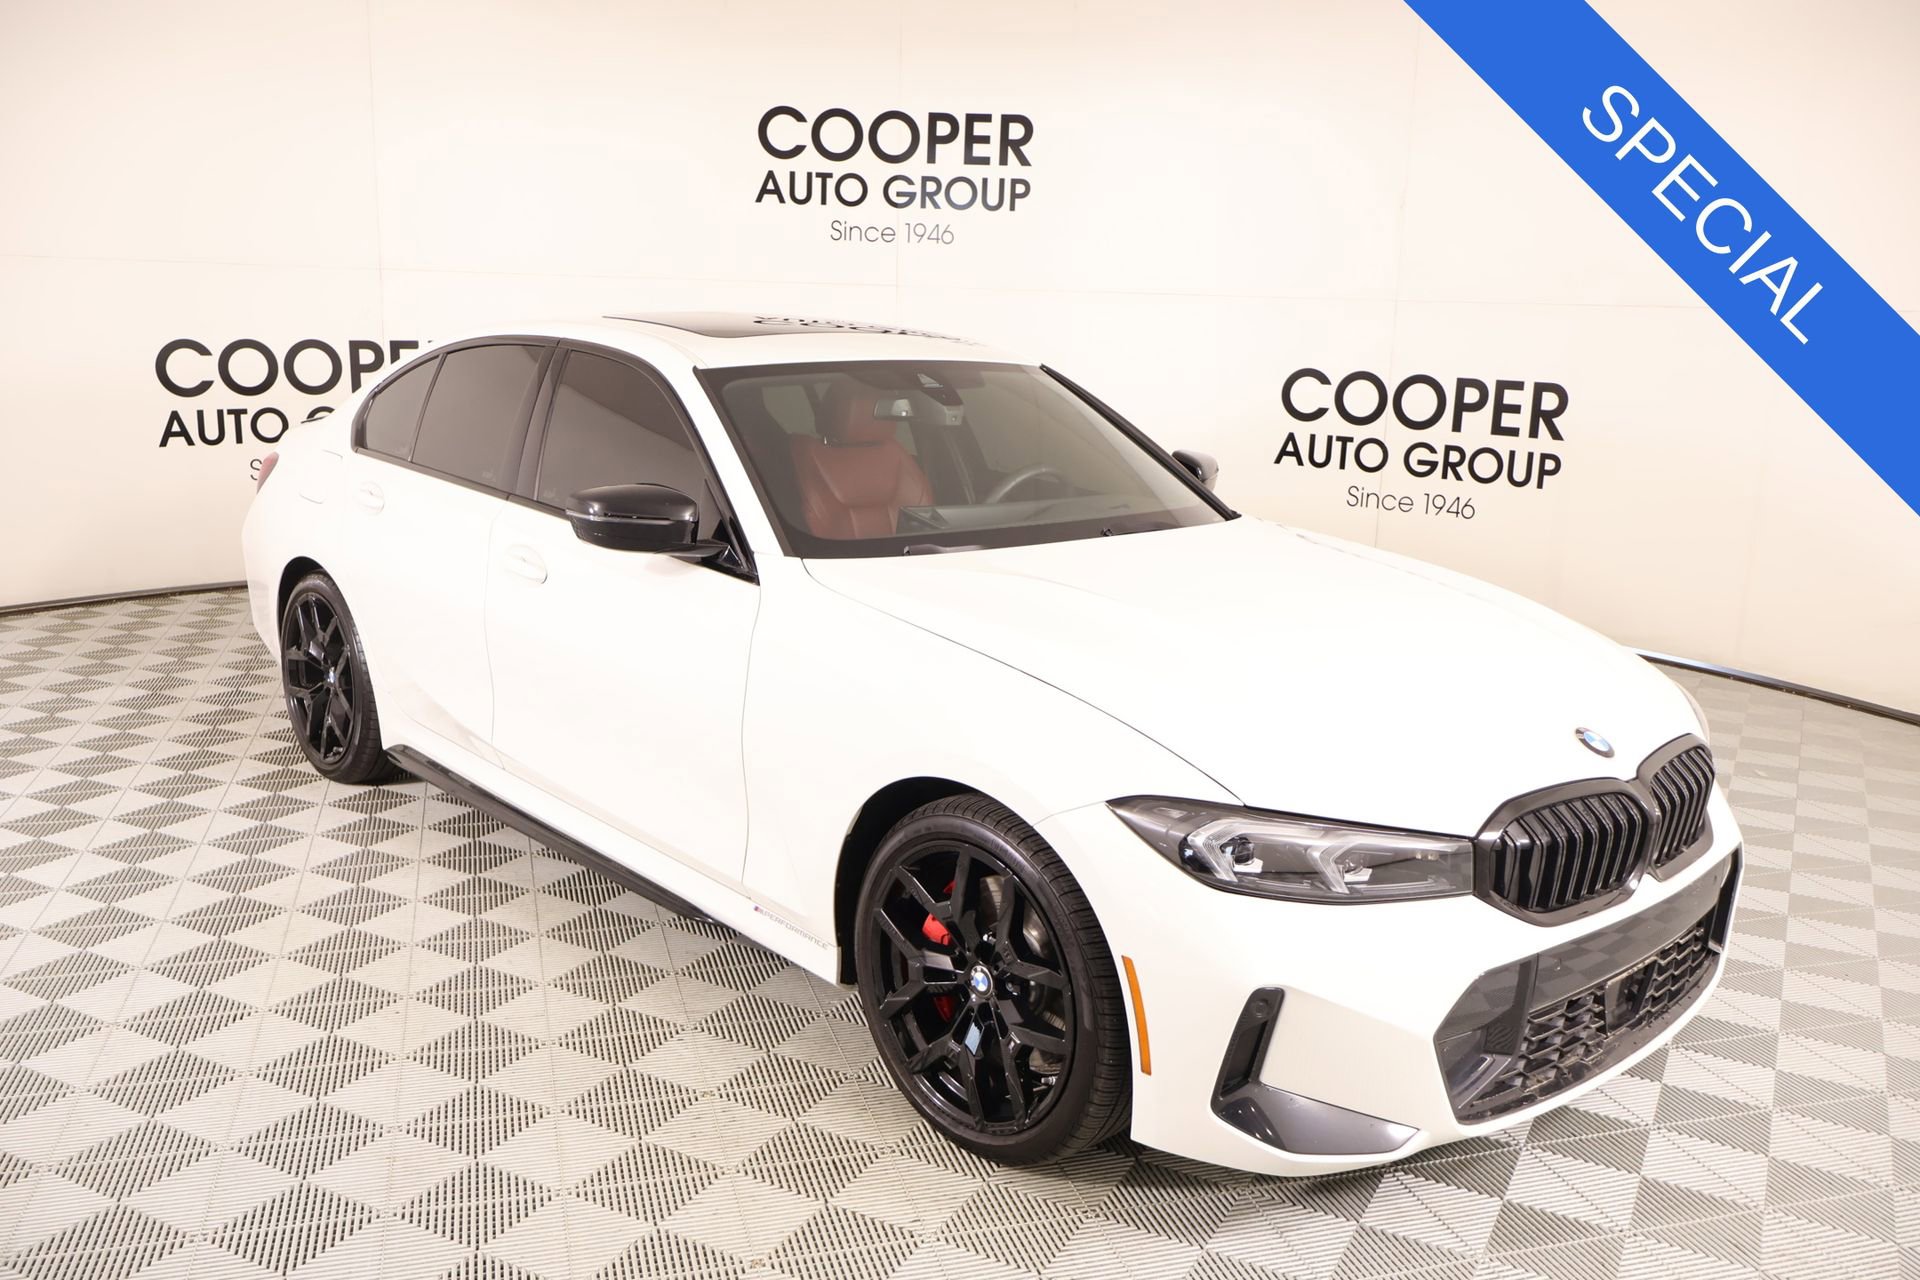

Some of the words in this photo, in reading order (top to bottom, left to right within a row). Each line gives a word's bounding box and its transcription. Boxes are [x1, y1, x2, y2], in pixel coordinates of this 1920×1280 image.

[758, 105, 1034, 167] COOPER
[755, 170, 868, 207] AUTO
[882, 174, 1031, 212] GROUP
[830, 220, 896, 243] Since
[904, 222, 955, 245] 1946
[155, 338, 433, 397] COOP
[158, 406, 289, 448] AUTO
[1281, 367, 1569, 441] COOPER
[1273, 432, 1389, 473] AUTO
[1403, 442, 1562, 490] GROUP
[1346, 485, 1414, 513] Since
[1424, 493, 1475, 519] 1946
